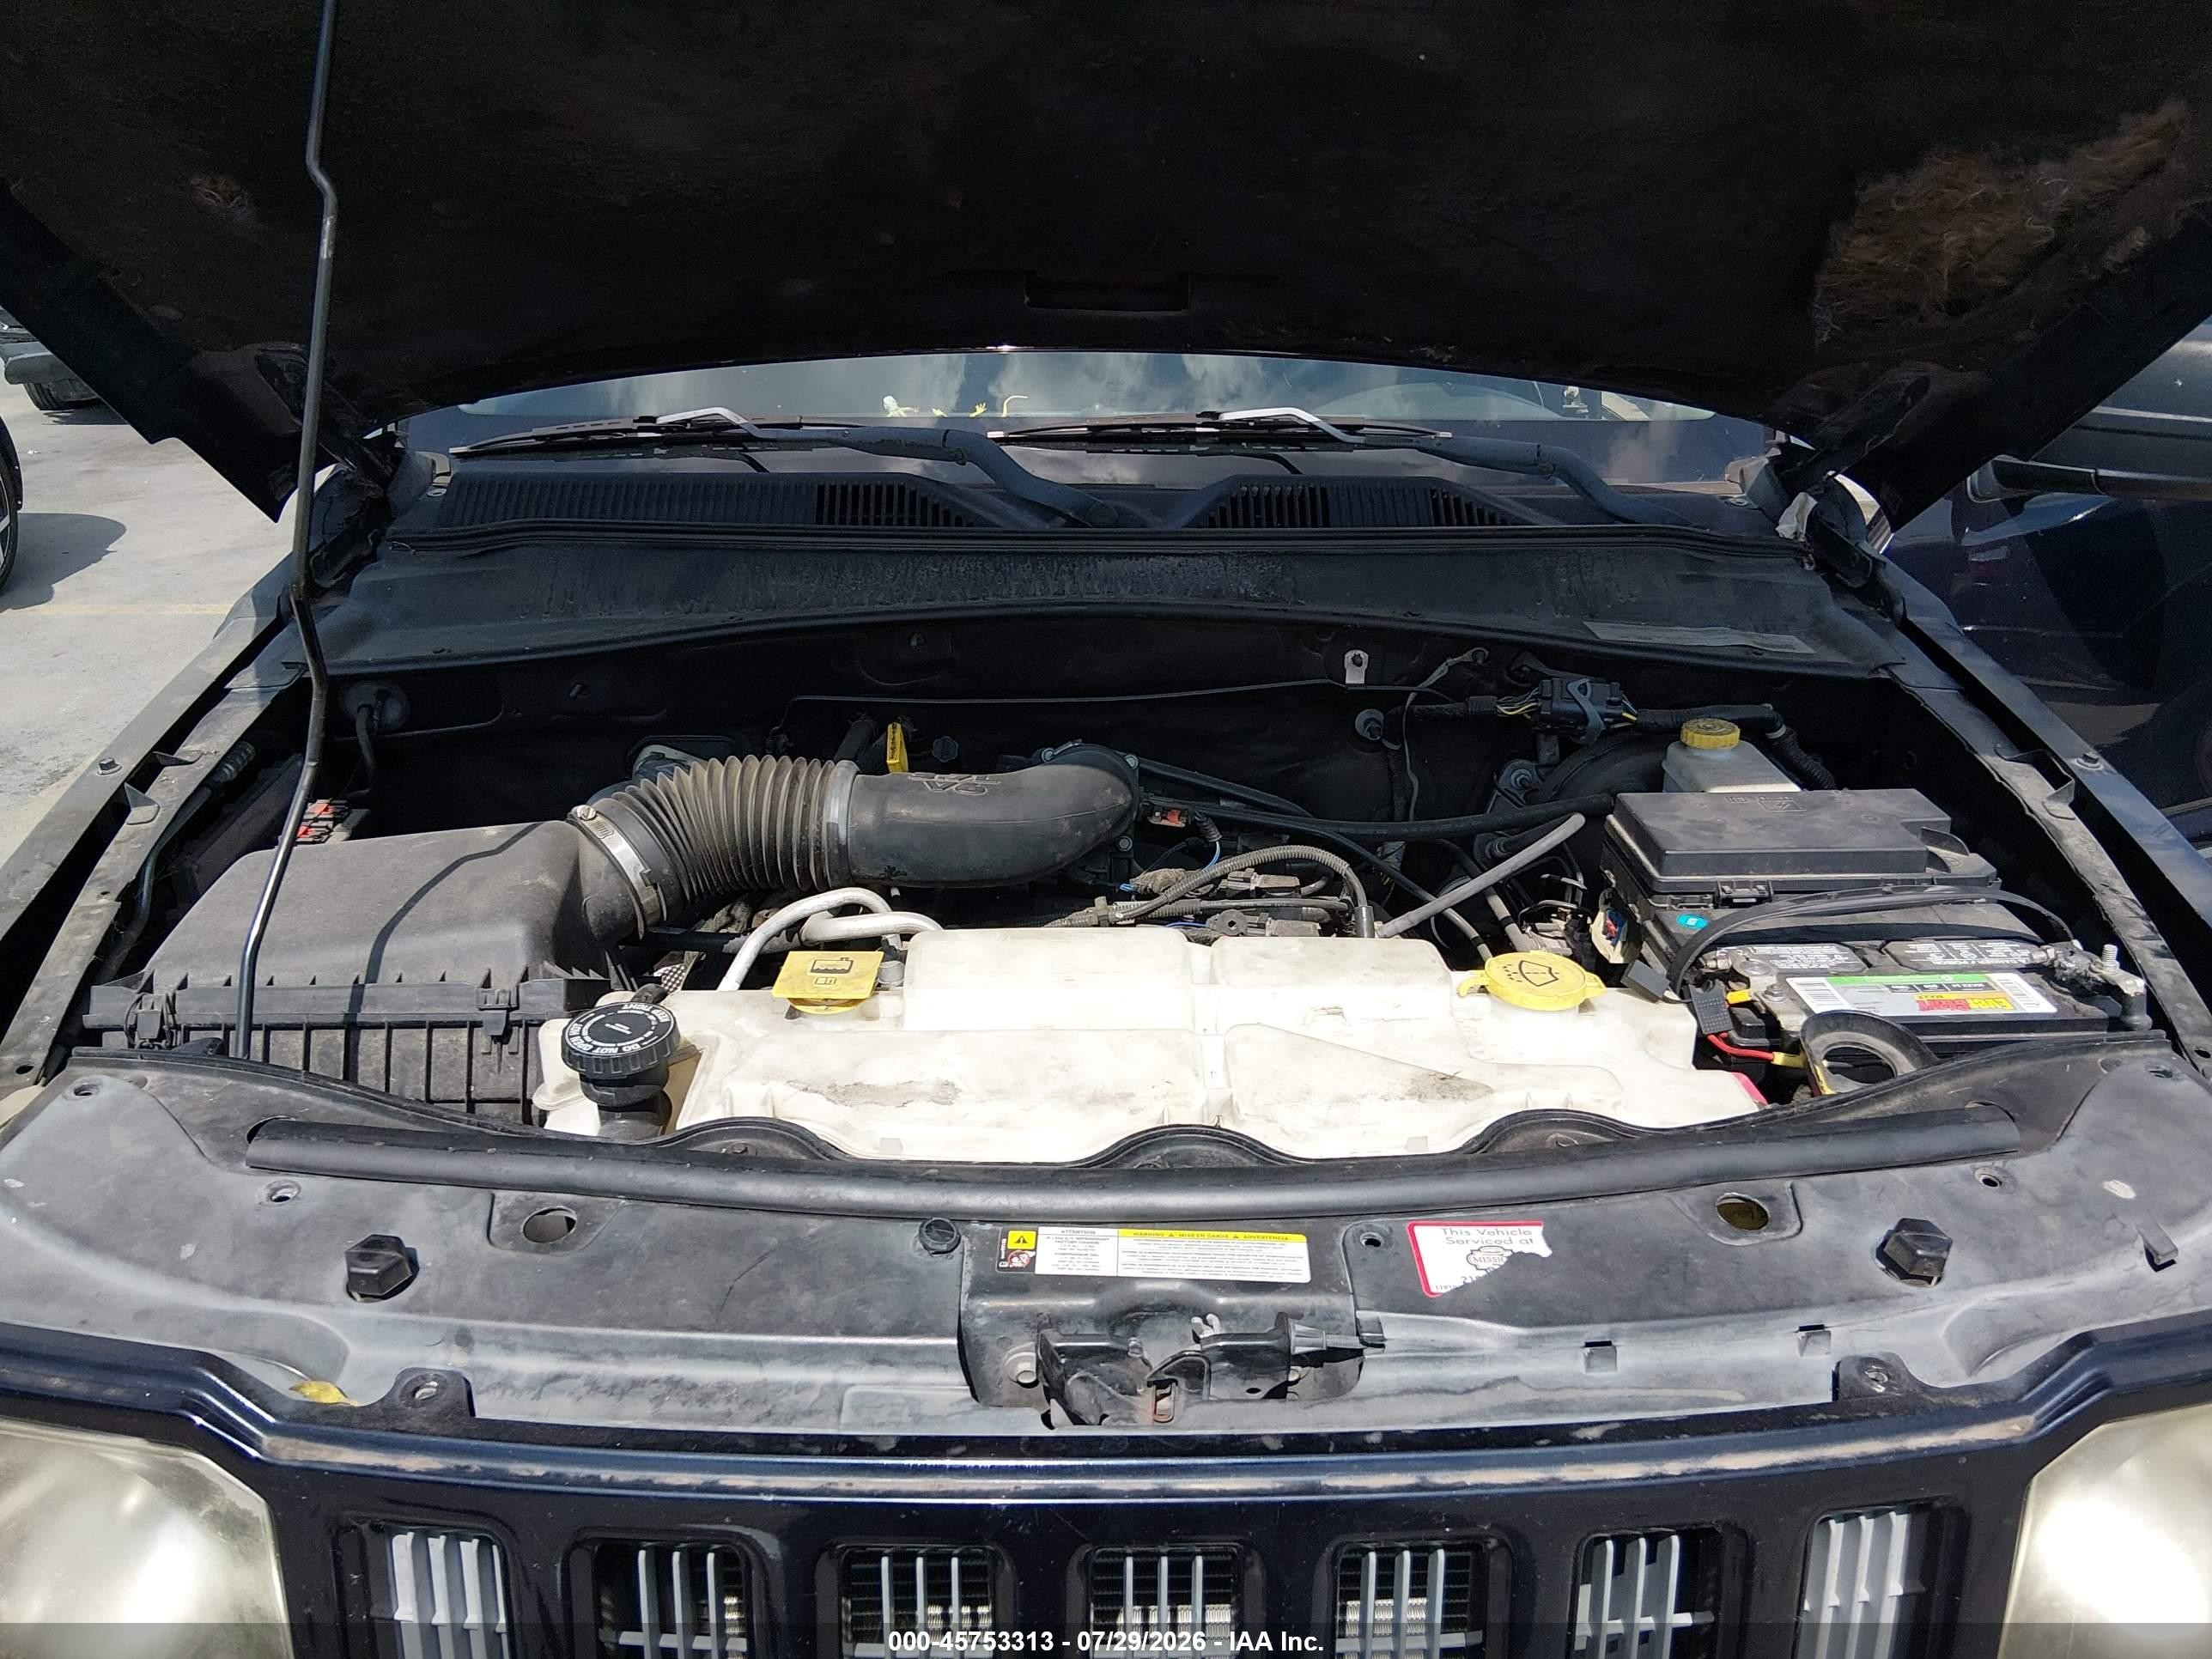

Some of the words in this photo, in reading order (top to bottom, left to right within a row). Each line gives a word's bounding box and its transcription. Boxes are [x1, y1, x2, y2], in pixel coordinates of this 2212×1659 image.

[622, 1003, 653, 1012] TIGHT
[652, 1009, 671, 1023] KEEP
[568, 1023, 583, 1036] HOT
[570, 1036, 593, 1051] OPEN
[1442, 1228, 1471, 1237] This
[1476, 1227, 1533, 1237] Vehicle
[1445, 1237, 1513, 1245] Serviced
[1519, 1237, 1534, 1245] at
